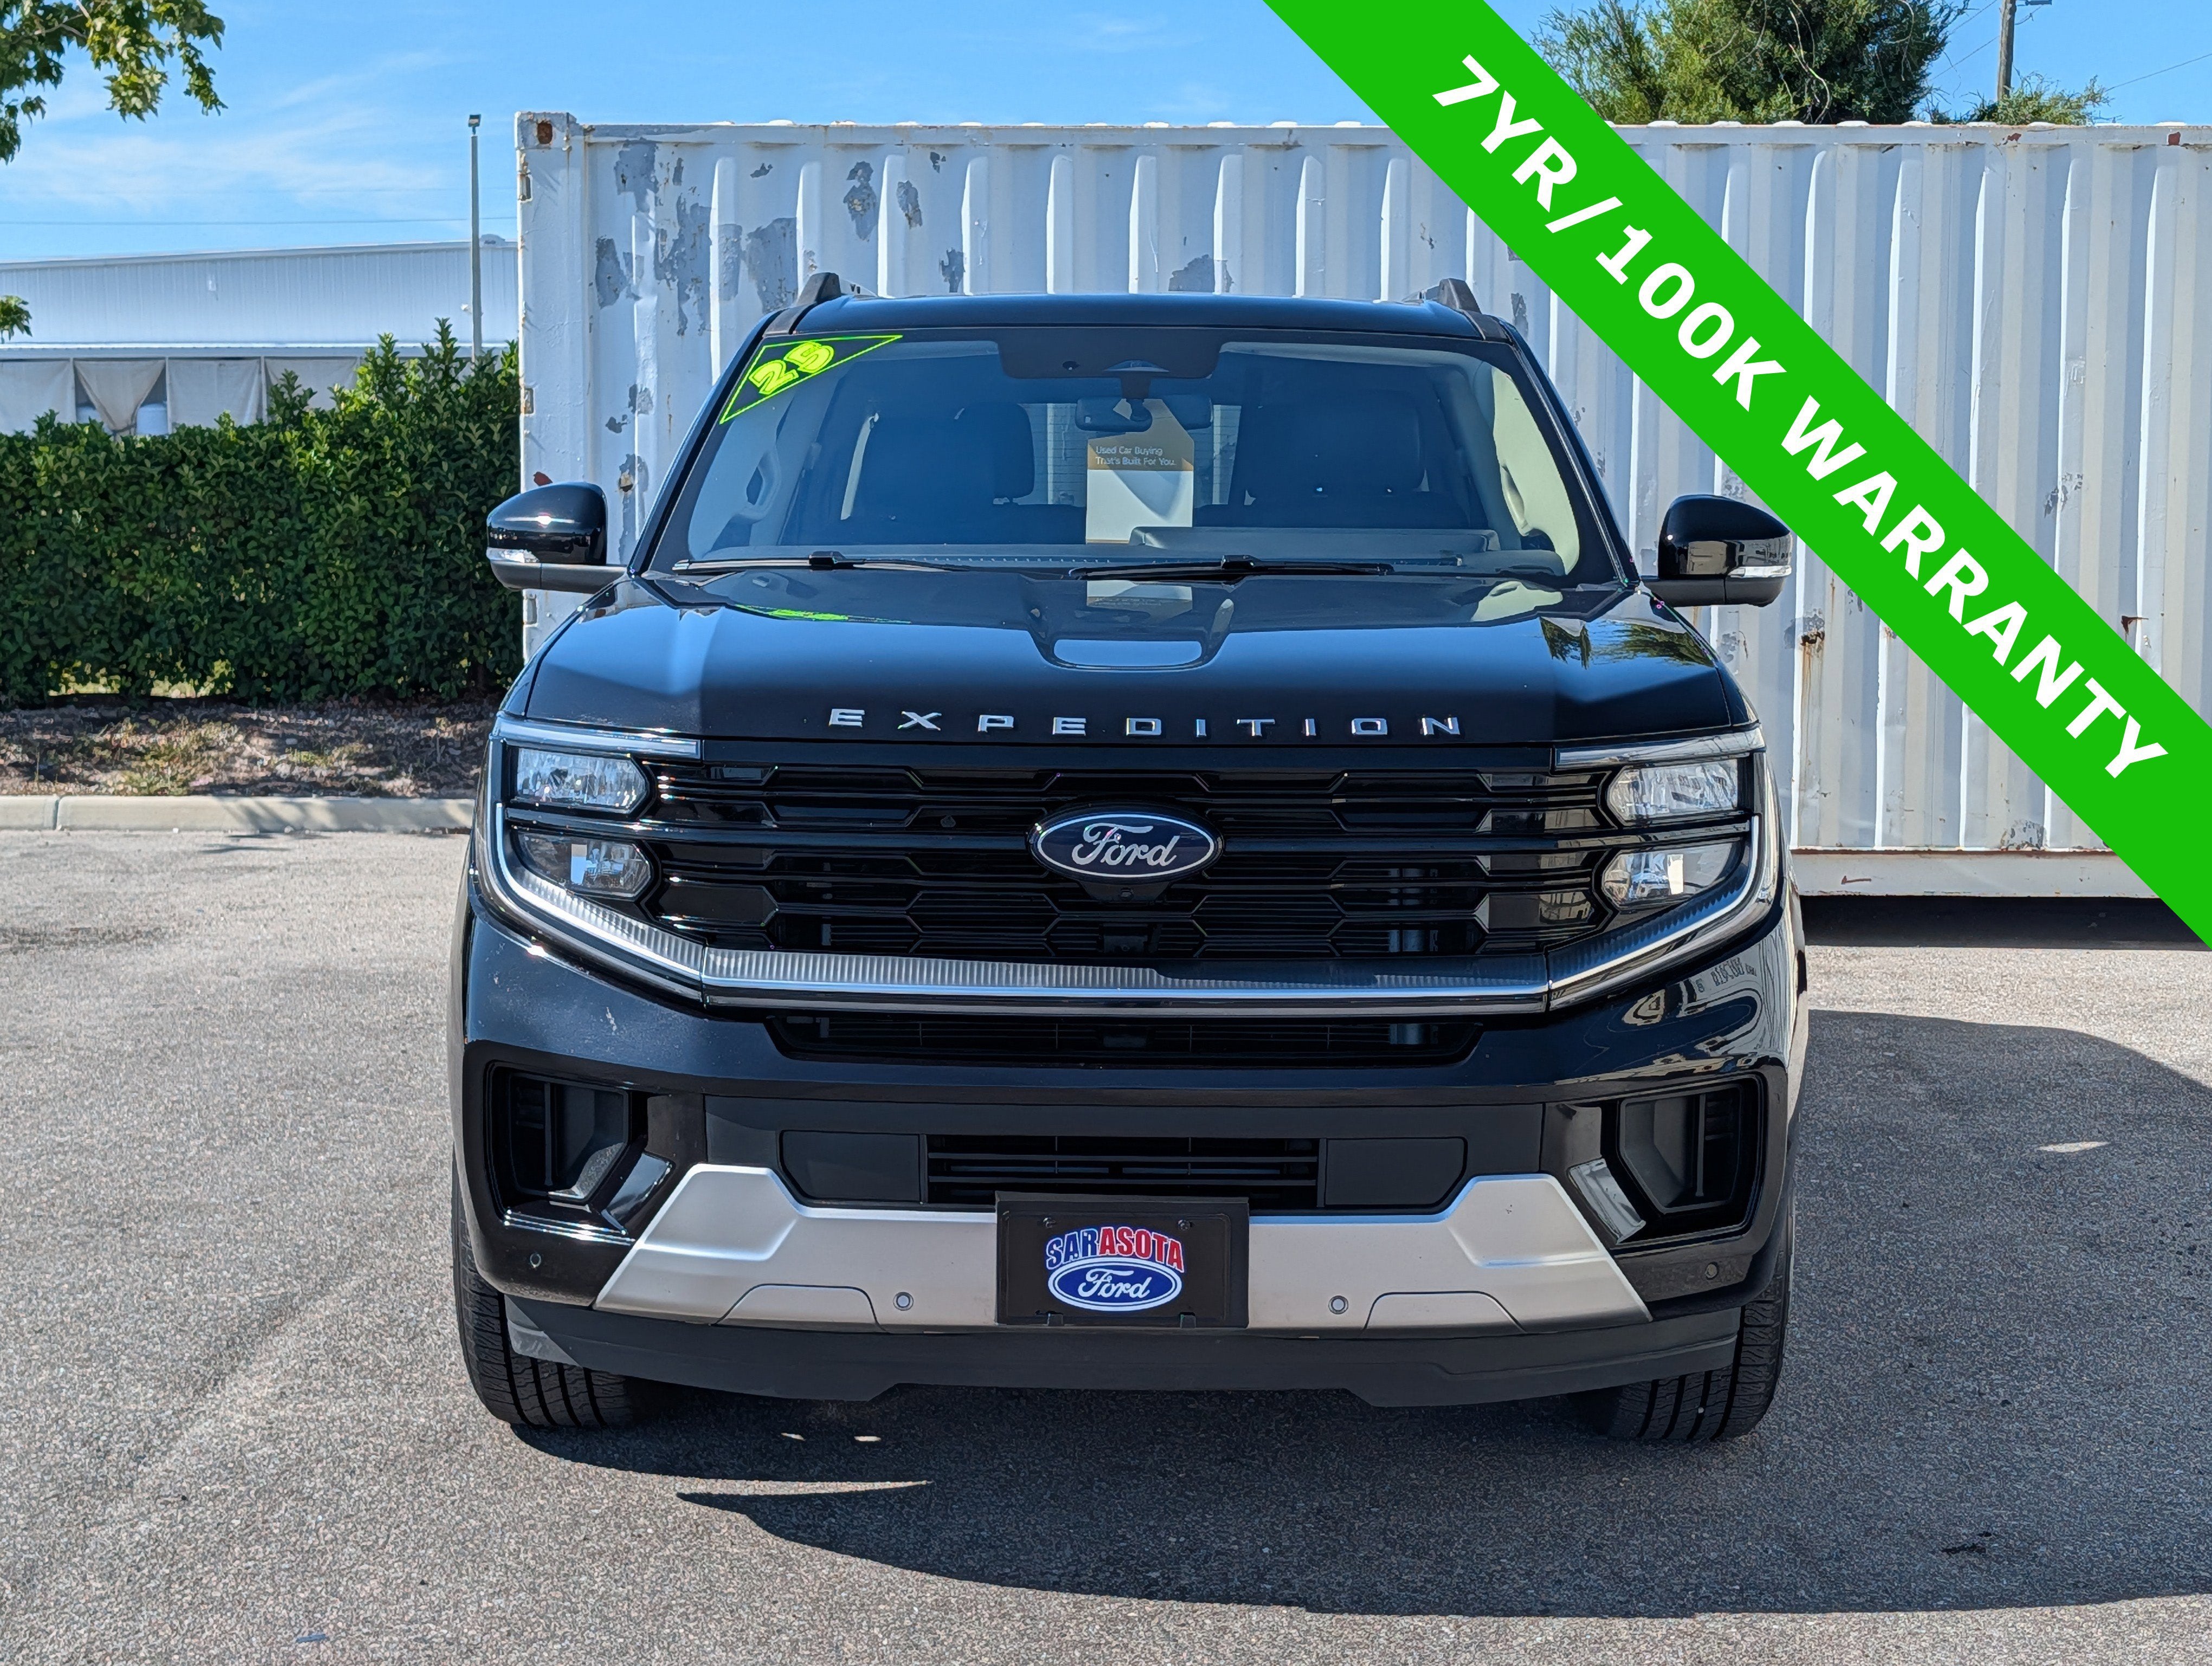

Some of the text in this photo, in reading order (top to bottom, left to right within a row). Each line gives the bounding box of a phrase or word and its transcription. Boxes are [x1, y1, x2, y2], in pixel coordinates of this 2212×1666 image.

[749, 341, 834, 395] 25
[1095, 456, 1121, 465] That's
[1122, 457, 1141, 465] Built
[1143, 457, 1156, 465] For
[1096, 446, 1163, 456] Used Car Buying
[828, 708, 1461, 738] EXPEDITION
[1072, 823, 1176, 868] Ford
[1045, 1226, 1185, 1273] SARASOTA
[1078, 1268, 1152, 1299] Ford
